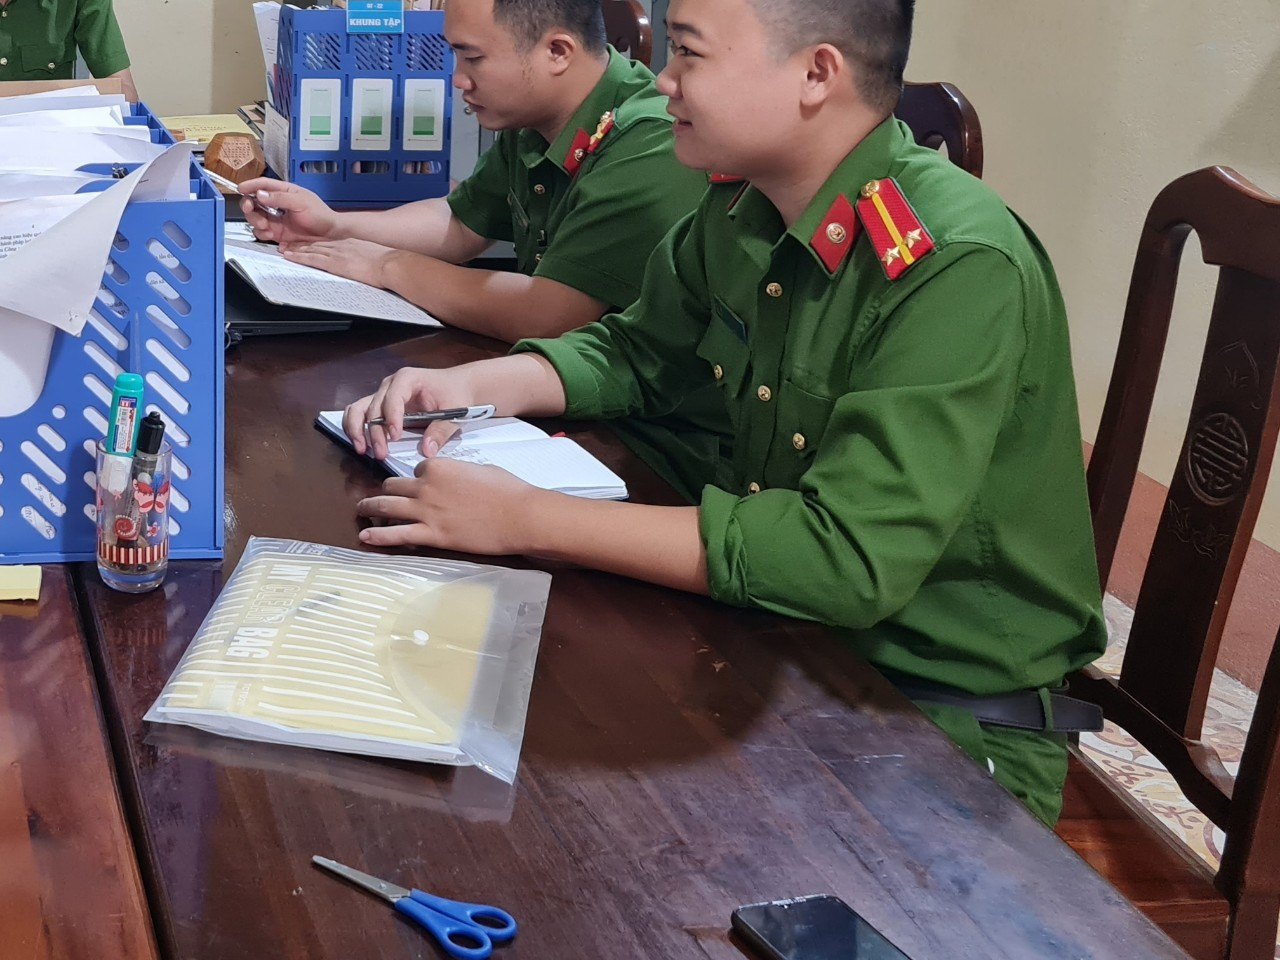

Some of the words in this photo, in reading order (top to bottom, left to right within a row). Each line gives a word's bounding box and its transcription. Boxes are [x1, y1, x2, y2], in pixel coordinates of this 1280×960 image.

[383, 17, 400, 28] TẬP
[267, 564, 312, 582] MY
[243, 584, 300, 624] CLEAR
[226, 627, 279, 659] BAG
